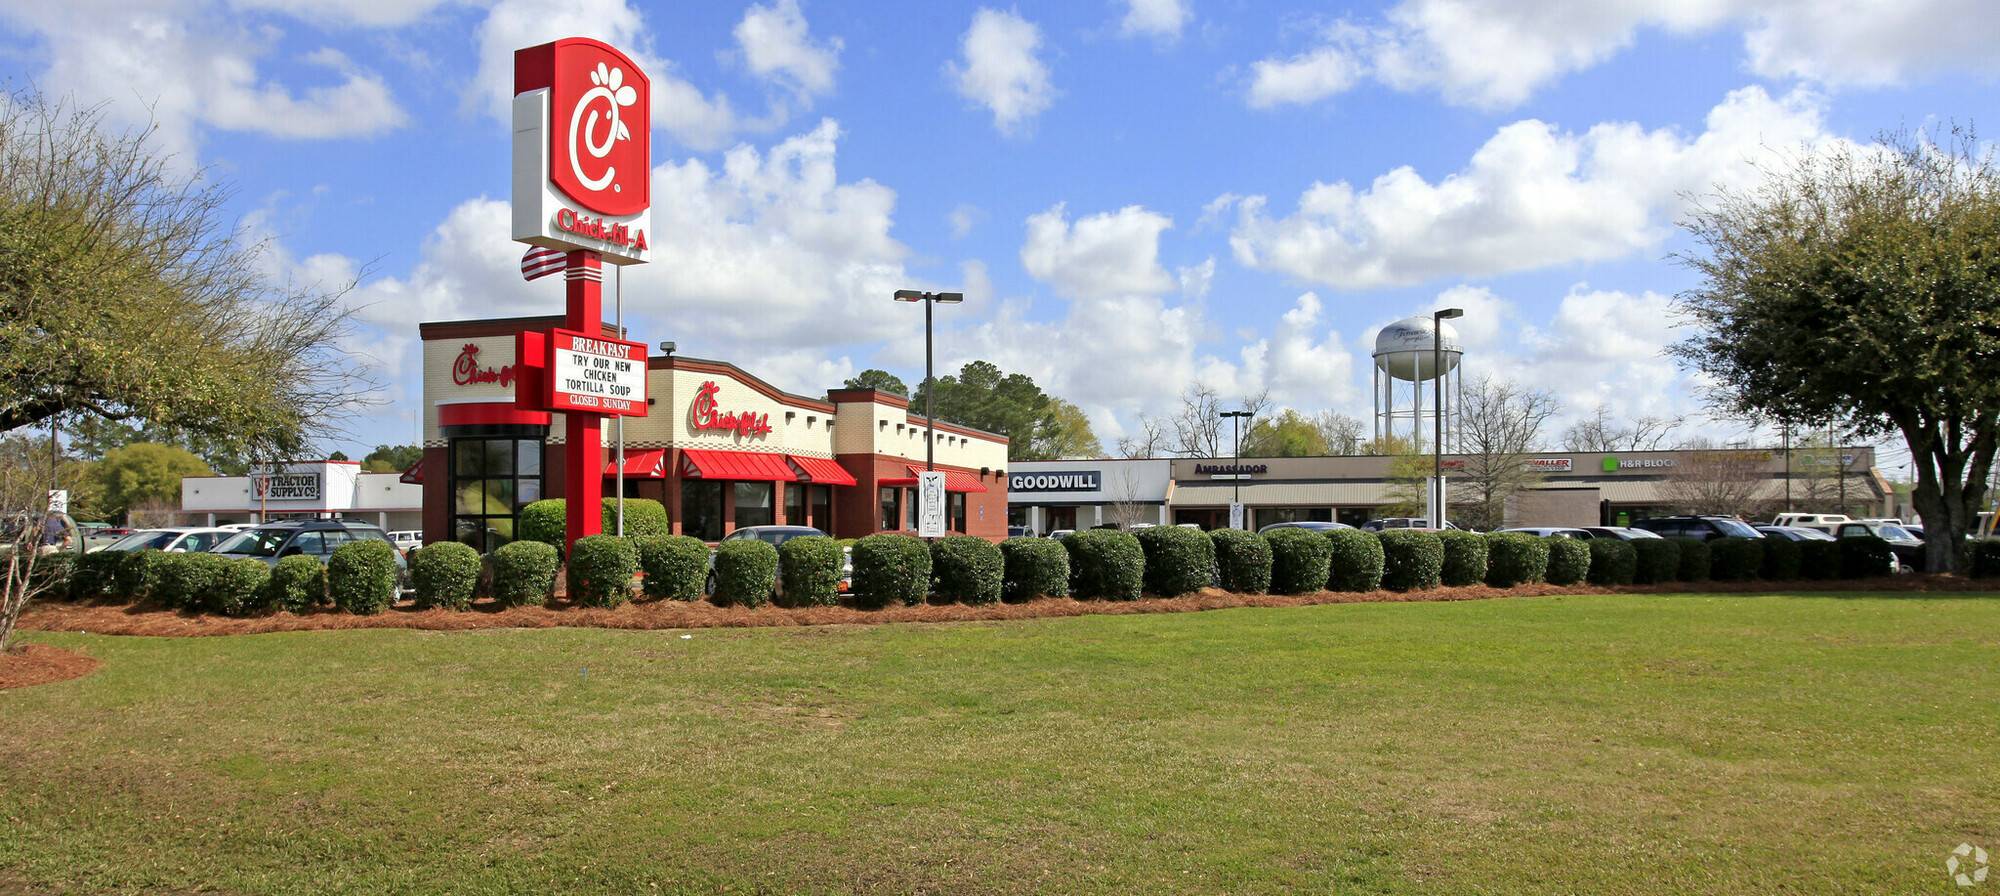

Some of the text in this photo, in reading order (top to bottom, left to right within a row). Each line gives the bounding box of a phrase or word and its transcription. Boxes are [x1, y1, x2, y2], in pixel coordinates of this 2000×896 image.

[557, 208, 648, 250] Chick-fil-A
[572, 337, 630, 359] BREAKFAST
[573, 354, 631, 372] TRY OUR NEW
[584, 369, 617, 383] CHICKEN
[566, 379, 631, 396] TORTILLA SOUP
[570, 394, 631, 410] CLOSED SUNDAY
[1620, 459, 1641, 468] H&R
[271, 476, 314, 486] TRACTOR
[1012, 475, 1096, 488] GOODWILL
[271, 486, 304, 497] SUPPLY
